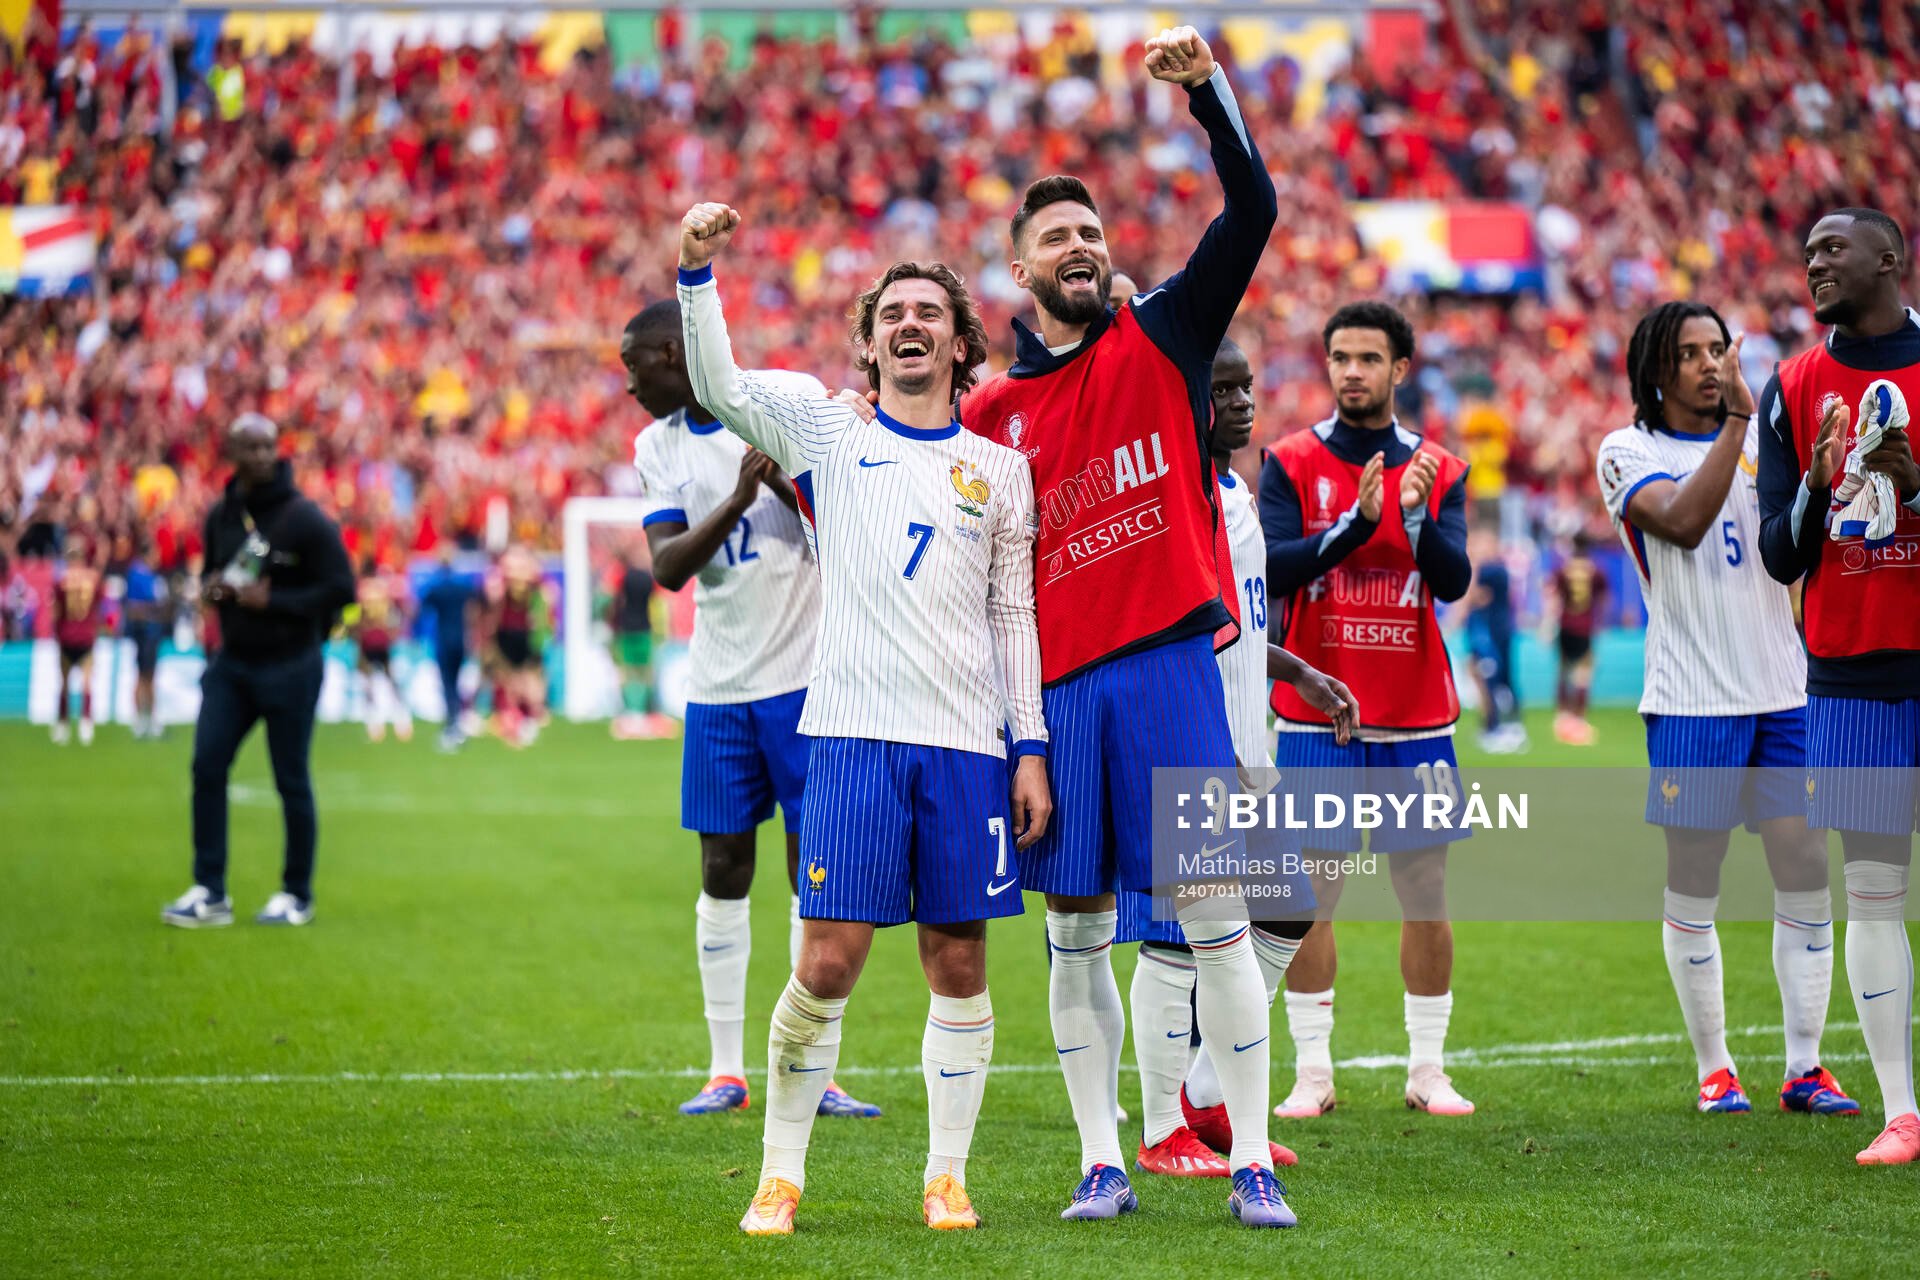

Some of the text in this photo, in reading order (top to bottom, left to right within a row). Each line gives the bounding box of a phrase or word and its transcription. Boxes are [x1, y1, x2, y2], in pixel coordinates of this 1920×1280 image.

[903, 522, 935, 581] 7
[1067, 505, 1162, 562] RESPECT
[1722, 521, 1744, 567] 5
[1244, 576, 1266, 632] 13
[1204, 777, 1228, 836] 9
[1413, 759, 1459, 813] 18
[988, 817, 1008, 877] 7
